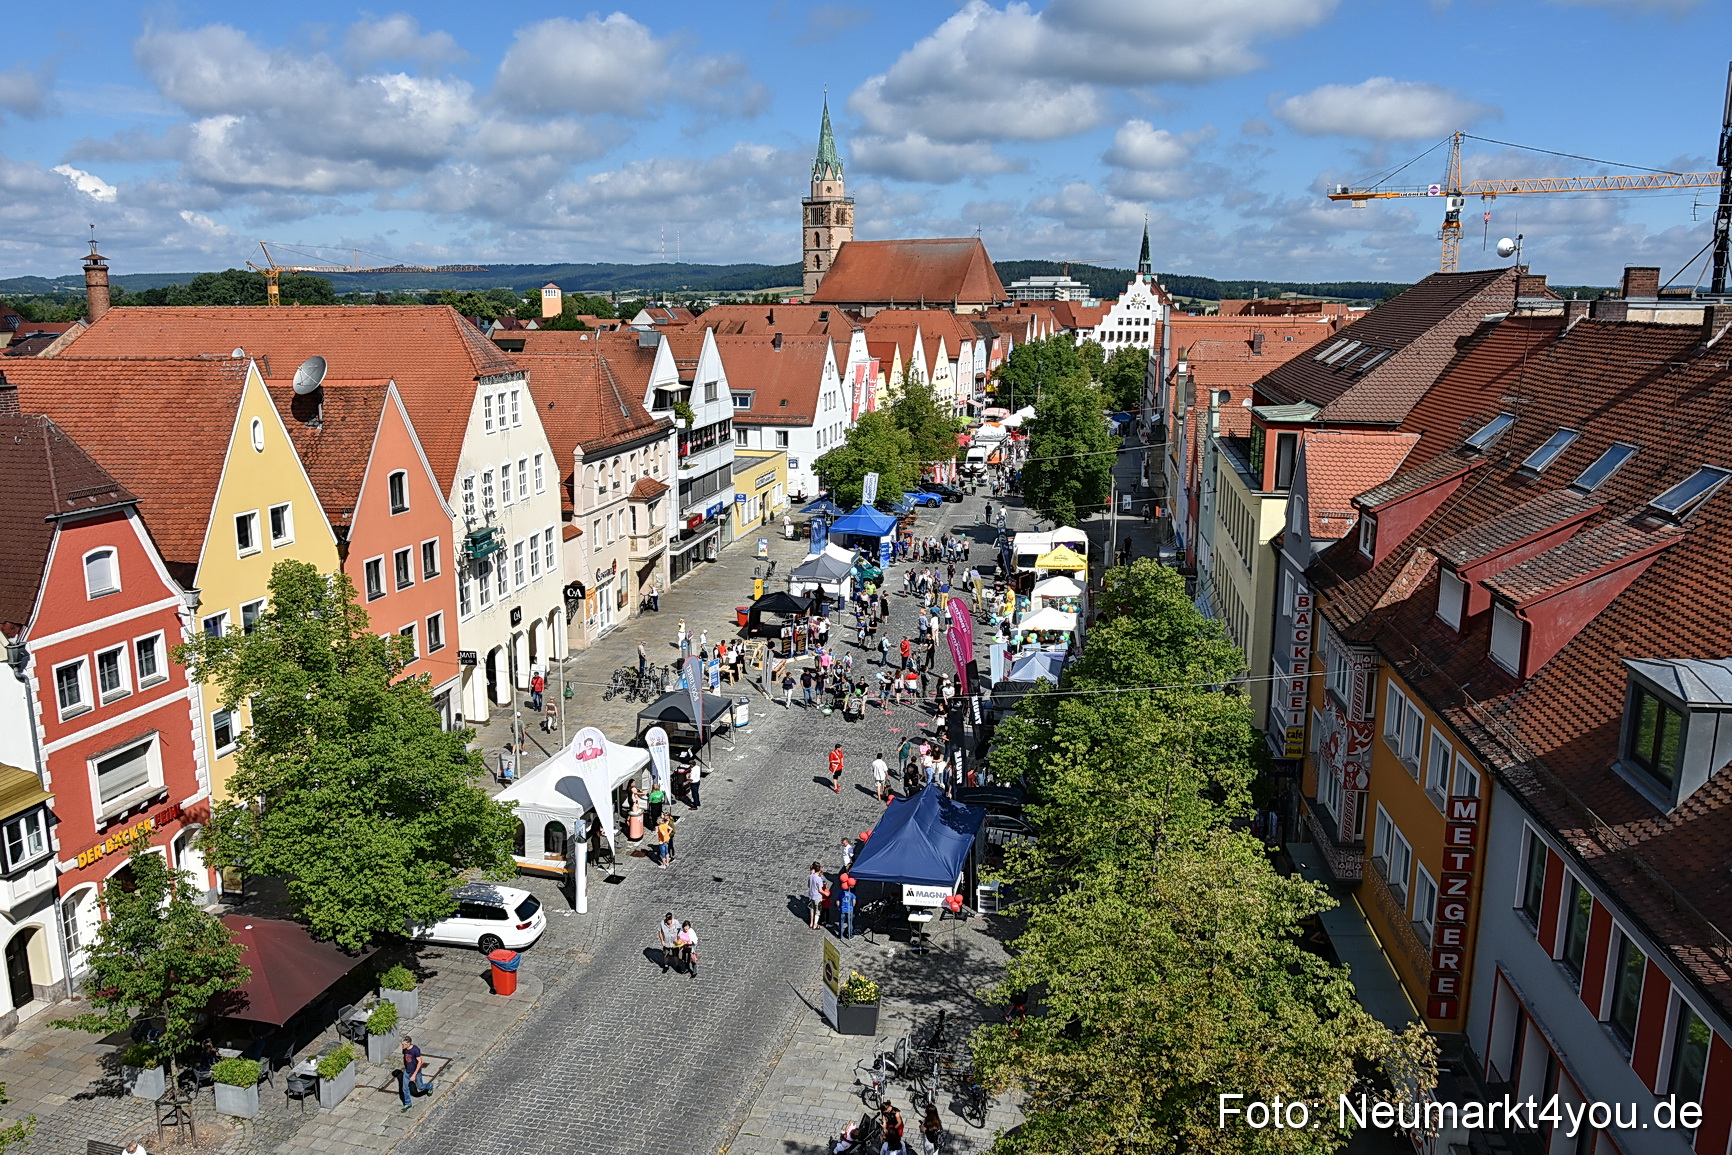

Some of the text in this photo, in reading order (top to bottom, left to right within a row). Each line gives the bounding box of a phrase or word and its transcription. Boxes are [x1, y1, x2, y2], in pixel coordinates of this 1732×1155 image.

[868, 379, 877, 399] SALE
[459, 651, 476, 659] MATT
[1291, 595, 1310, 725] BÄCKEREI
[1286, 729, 1303, 740] café
[77, 845, 103, 869] DER
[105, 818, 153, 854] BÄCKER
[915, 890, 948, 899] MAGNA
[1437, 801, 1477, 1018] METZGEREI
